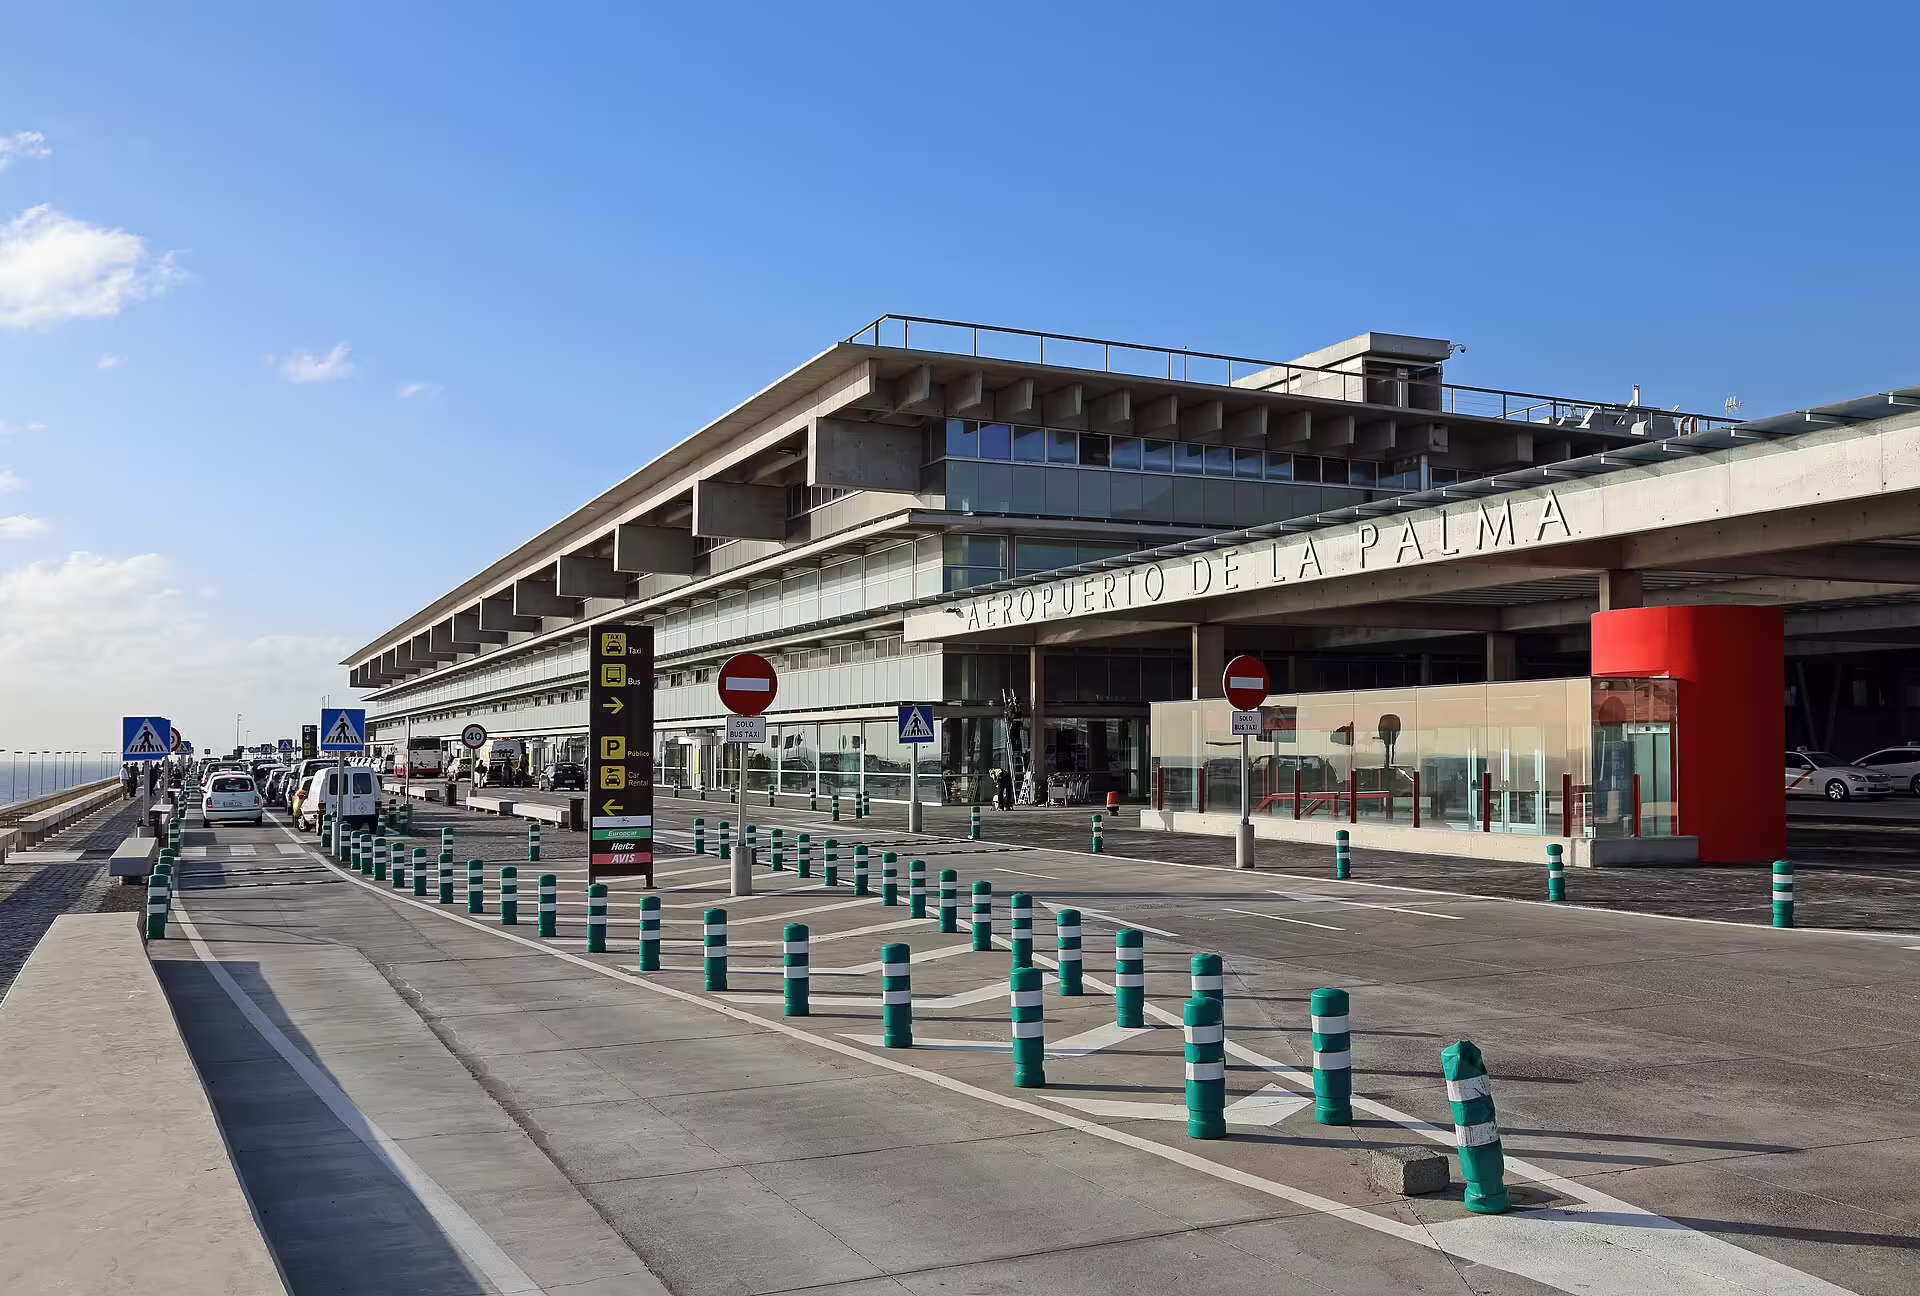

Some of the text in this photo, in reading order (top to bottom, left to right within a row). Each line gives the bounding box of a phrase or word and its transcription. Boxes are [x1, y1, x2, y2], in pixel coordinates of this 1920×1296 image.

[968, 488, 1572, 630] AEROPUERTO DE LA PALMA
[628, 646, 642, 655] Taxi
[627, 677, 641, 686] Bus
[467, 732, 482, 740] 40
[606, 739, 620, 757] P
[627, 771, 640, 779] Car
[628, 779, 649, 787] Rental
[610, 842, 636, 851] Hertz
[610, 853, 636, 864] AVIS
